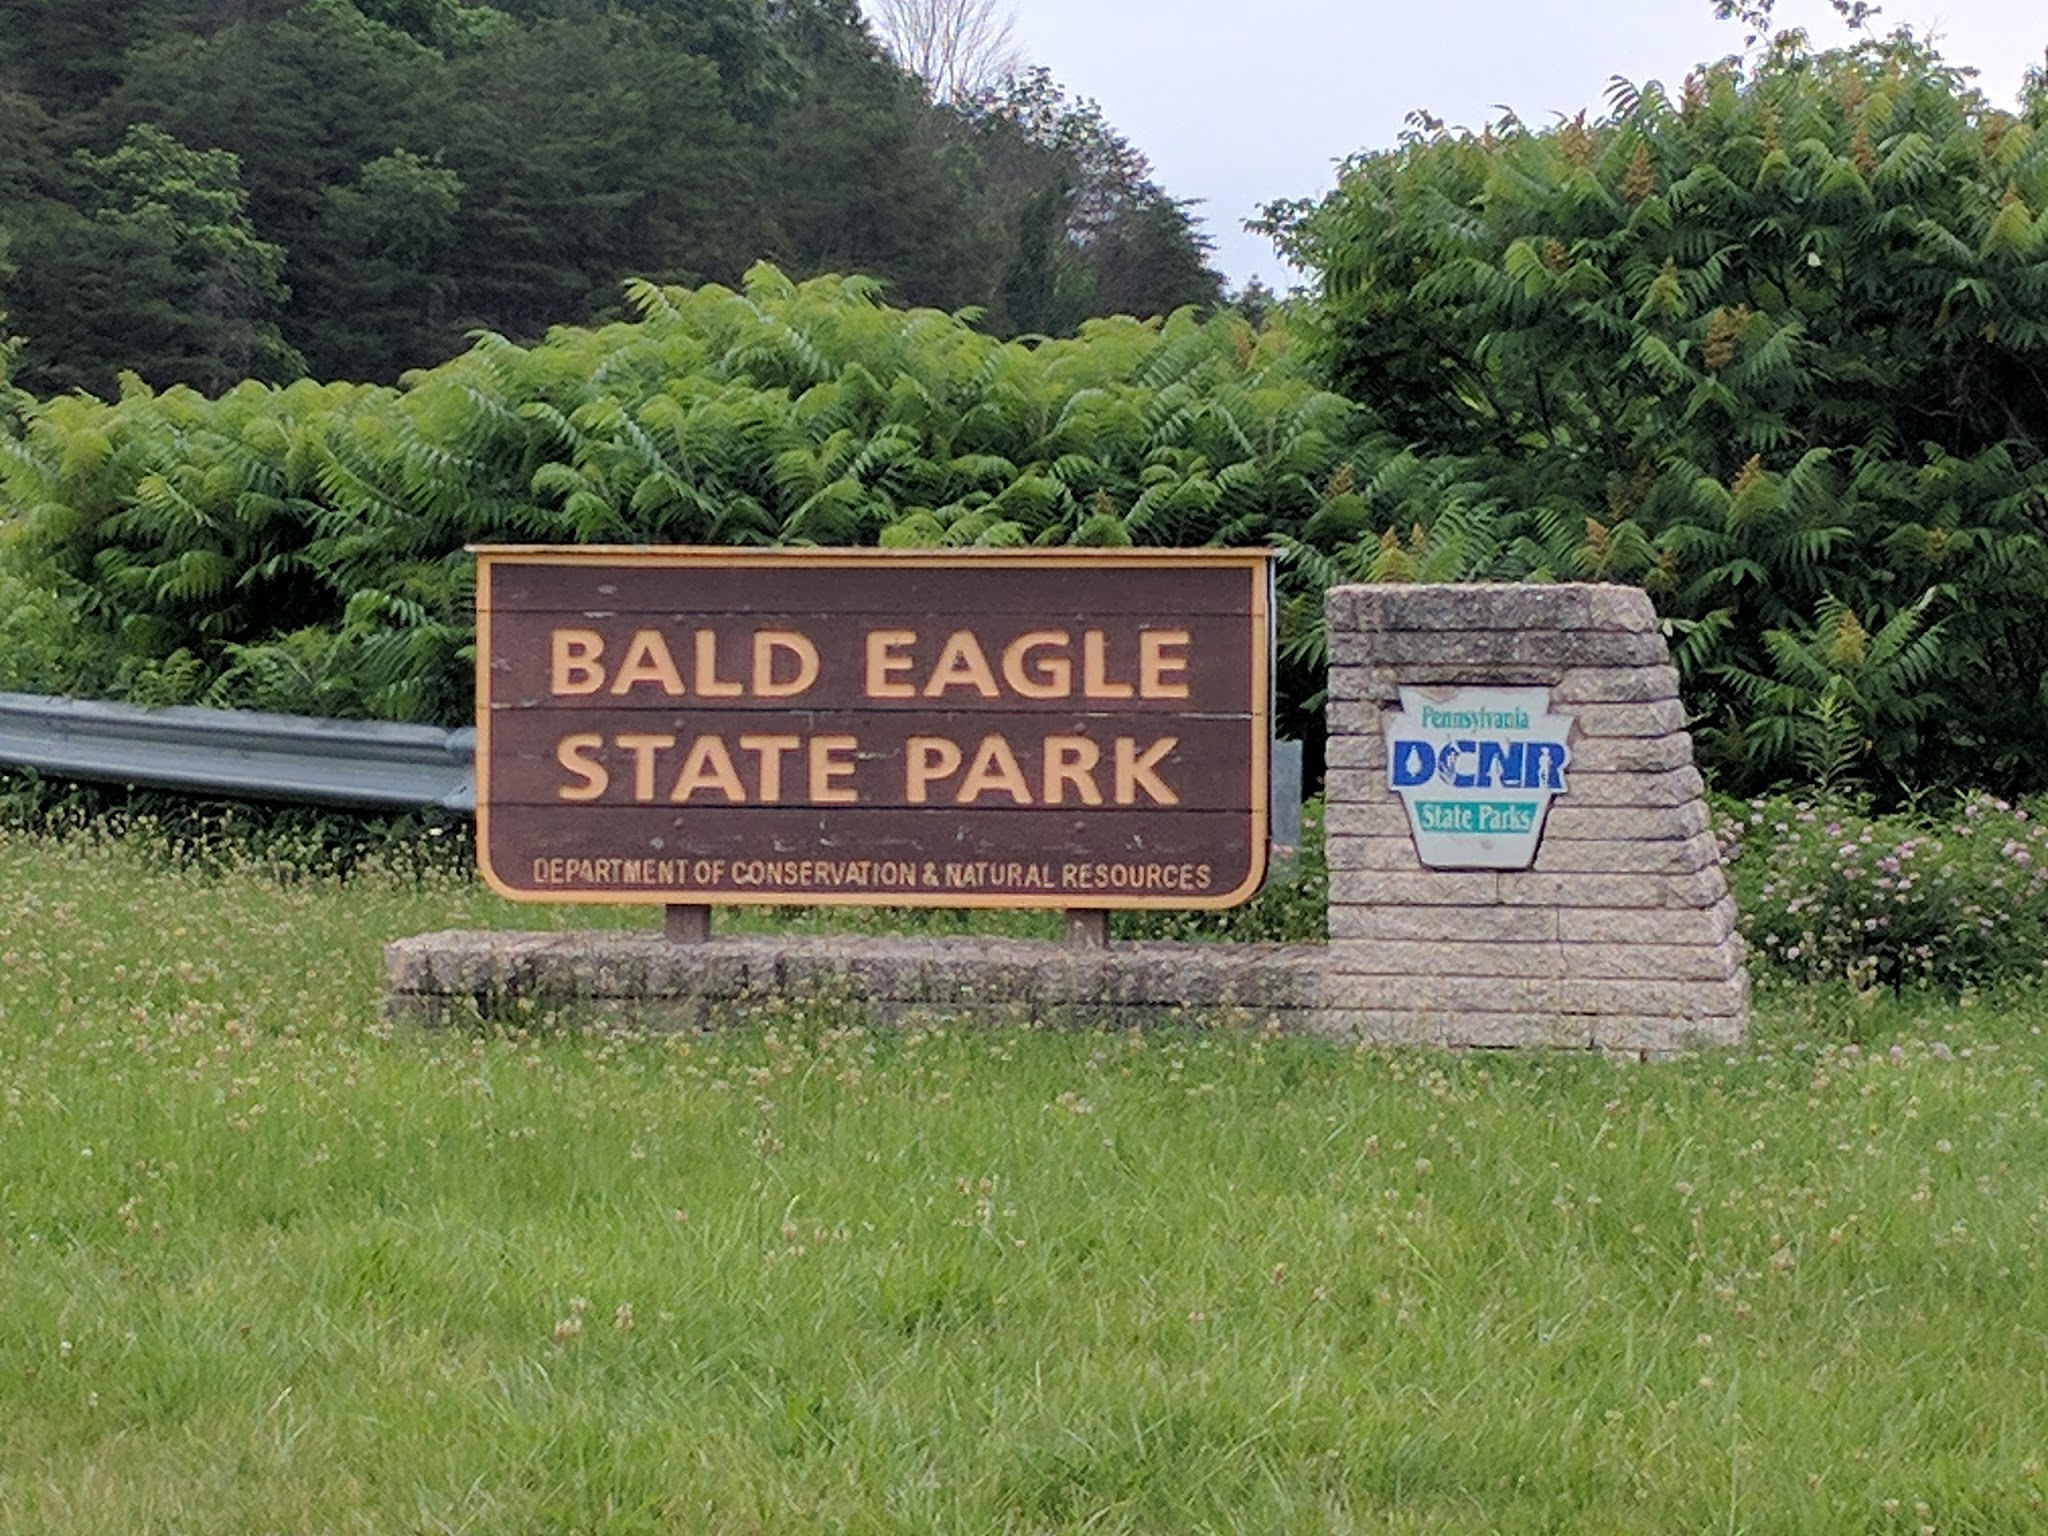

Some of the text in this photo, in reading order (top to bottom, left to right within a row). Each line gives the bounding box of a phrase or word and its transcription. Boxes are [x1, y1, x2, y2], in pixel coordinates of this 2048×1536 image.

[551, 629, 1191, 700] BALD EAGLE
[1422, 705, 1528, 731] Pennsylvania
[555, 733, 1181, 806] STATE PARK
[1392, 741, 1566, 789] DCNR
[1422, 803, 1531, 831] State Parks
[533, 857, 1212, 890] DEPARTMENT OF CONSERVATION & NATURAL RESOURCES
